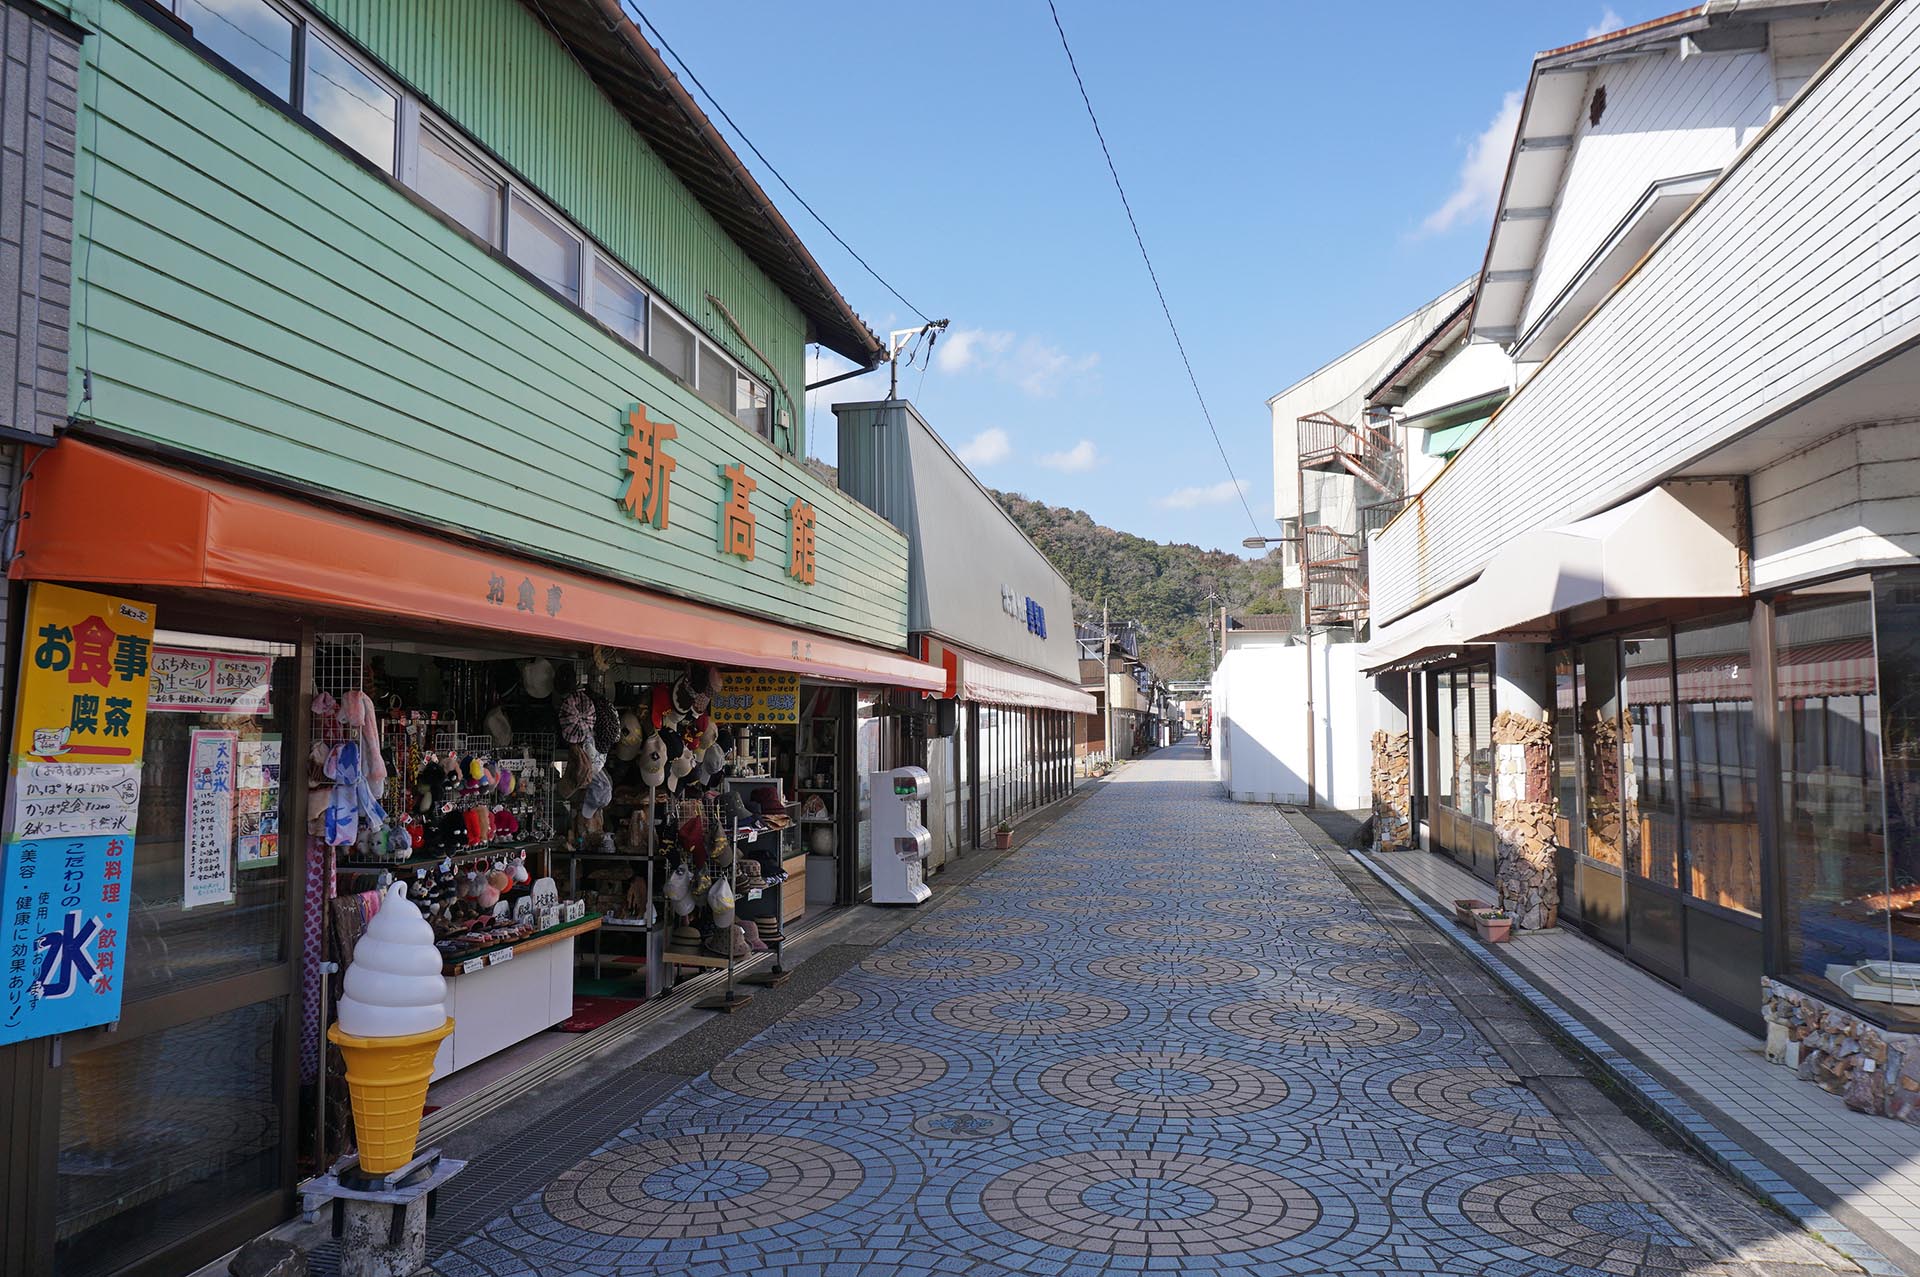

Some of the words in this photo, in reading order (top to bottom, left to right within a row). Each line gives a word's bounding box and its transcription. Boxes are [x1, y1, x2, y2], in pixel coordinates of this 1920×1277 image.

[486, 571, 563, 617] お食事
[34, 615, 150, 688] お食事
[216, 673, 259, 689] お食事処
[70, 693, 133, 737] 喫茶
[213, 742, 230, 793] 天然氷
[61, 842, 85, 907] こだわりの
[94, 839, 124, 995] お料理・飲料水
[26, 909, 104, 1000] 水
[29, 892, 50, 1011] 使用しております
